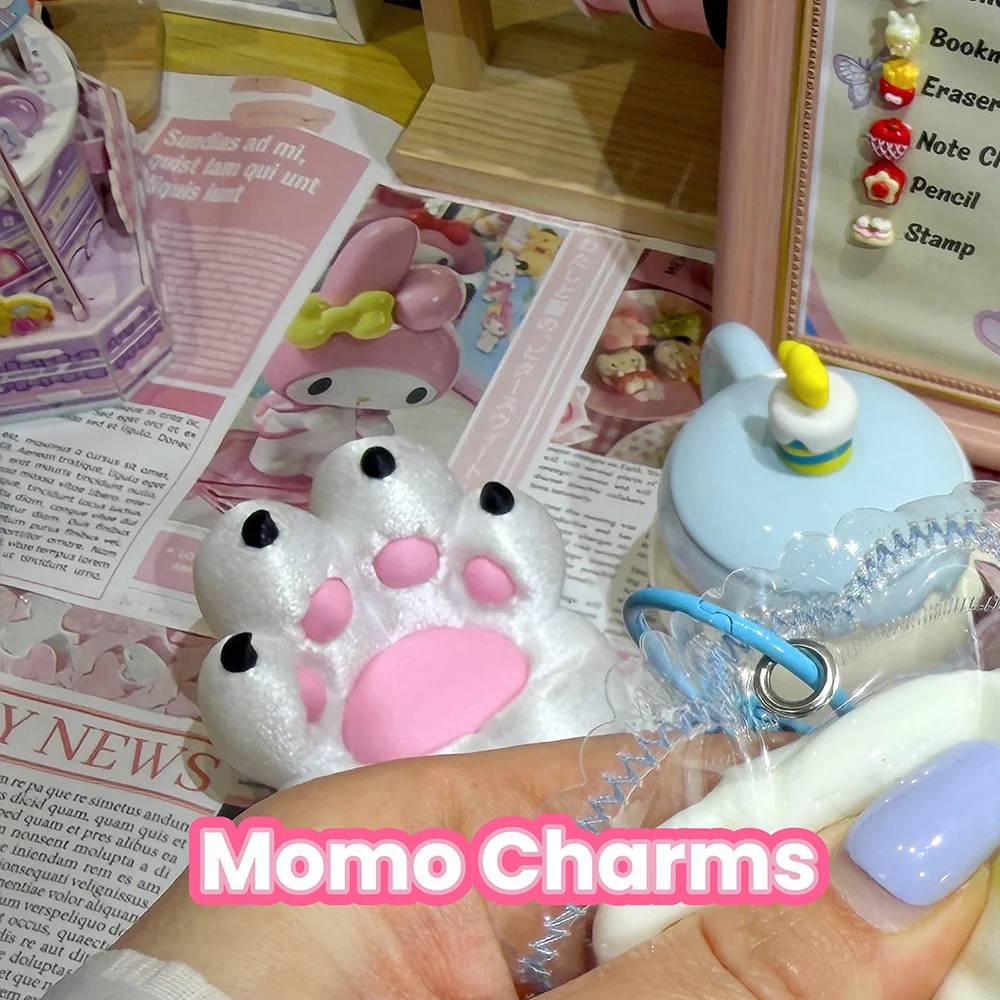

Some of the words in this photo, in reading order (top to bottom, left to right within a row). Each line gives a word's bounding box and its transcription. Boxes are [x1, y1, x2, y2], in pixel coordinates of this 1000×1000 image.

[916, 131, 970, 161] Note
[910, 176, 981, 210] Pencil
[905, 223, 976, 260] Stamp
[35, 715, 221, 792] NEWS
[138, 826, 170, 843] quis
